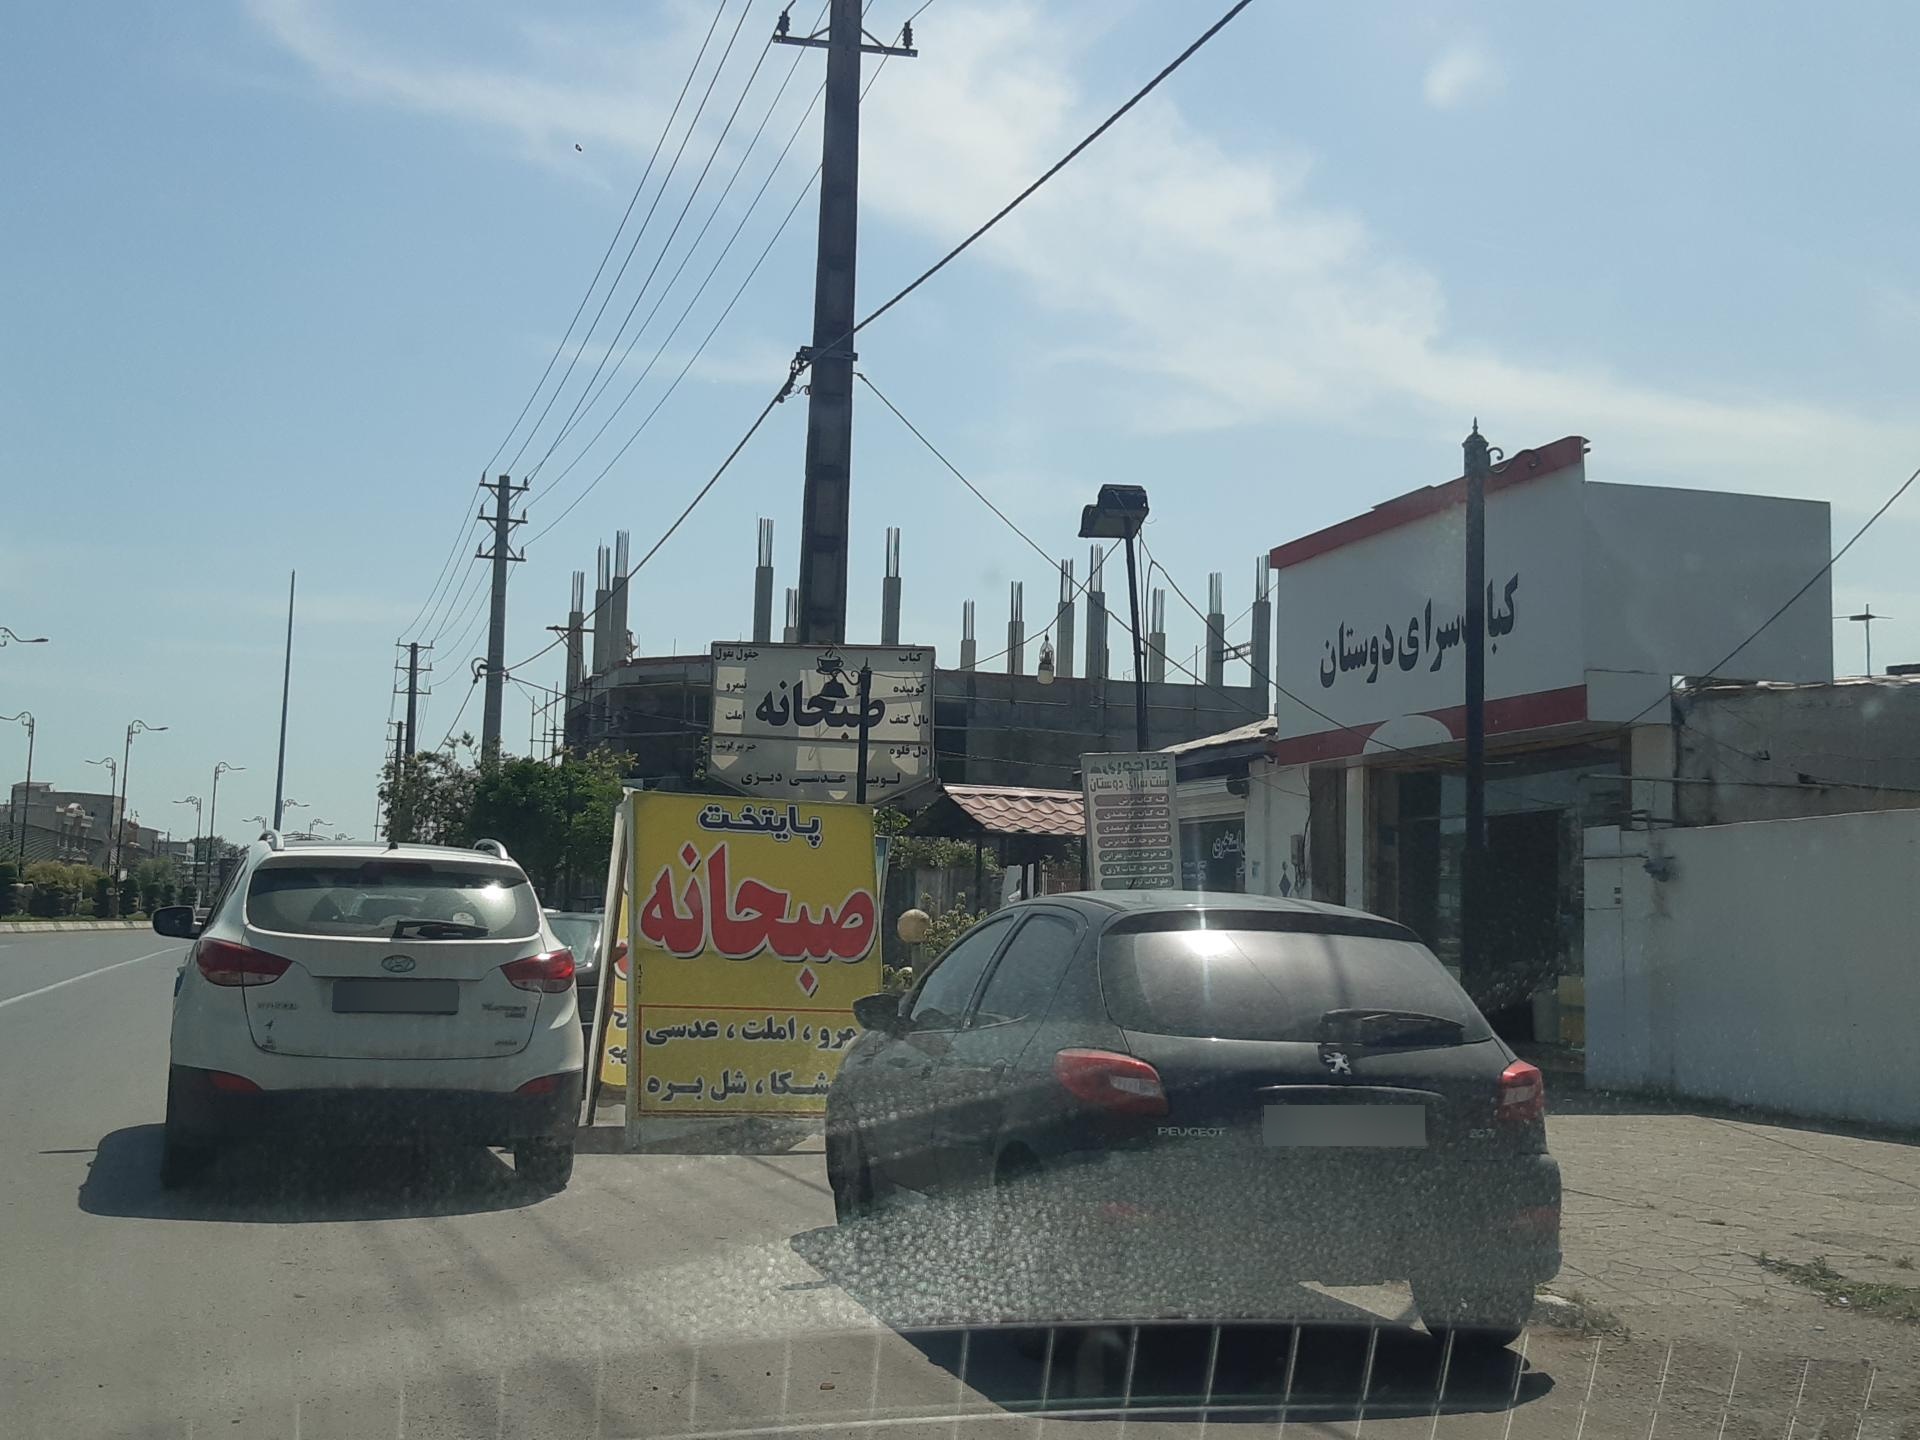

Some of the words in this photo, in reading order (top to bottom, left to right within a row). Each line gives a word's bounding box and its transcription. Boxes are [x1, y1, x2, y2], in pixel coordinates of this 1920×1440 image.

[1461, 572, 1519, 654] کبا
[1398, 598, 1461, 672] سرای
[898, 652, 922, 664] کباب
[1320, 621, 1395, 688] دوستان
[726, 679, 747, 692] نیمرو
[893, 684, 926, 697] کوبیده
[725, 710, 746, 720] املت
[889, 714, 911, 725] کتف
[913, 714, 929, 727] بال
[889, 744, 910, 758] قلوه
[913, 745, 928, 758] دل
[740, 771, 783, 786] دیزی
[788, 772, 847, 786] عدسی
[866, 771, 901, 788] لوبی
[1090, 777, 1124, 792] دوستان
[698, 804, 822, 847] پایتخت
[640, 842, 877, 996] صبحانه
[645, 1019, 719, 1045] عدسی
[646, 1076, 703, 1102] بره
[710, 1070, 748, 1102] شل
[1156, 1126, 1227, 1137] PEUGEOT
